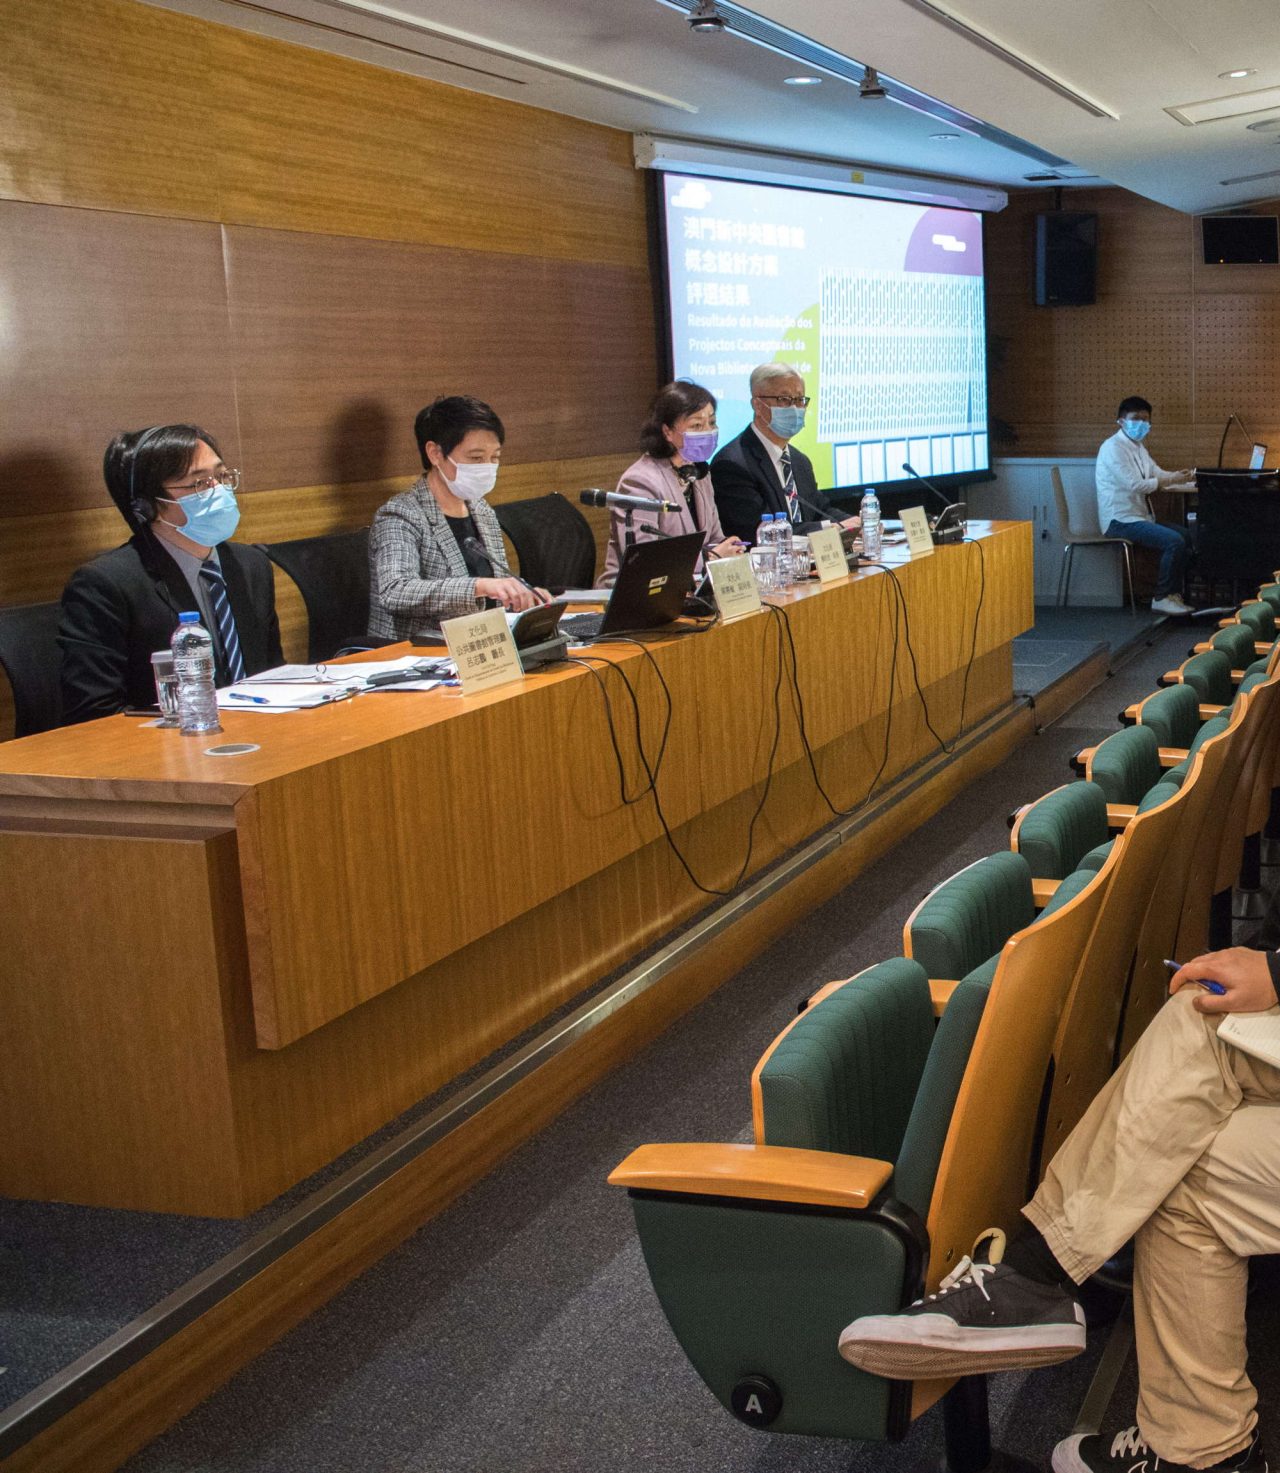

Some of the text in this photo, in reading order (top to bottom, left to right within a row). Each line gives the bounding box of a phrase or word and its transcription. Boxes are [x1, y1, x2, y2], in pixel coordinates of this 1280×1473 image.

[687, 314, 738, 328] Resultado
[740, 315, 751, 328] da
[797, 317, 813, 329] dos
[688, 338, 736, 354] Projectos
[795, 340, 806, 351] da
[690, 362, 716, 375] Nova
[800, 361, 812, 373] de
[745, 1393, 763, 1414] A
